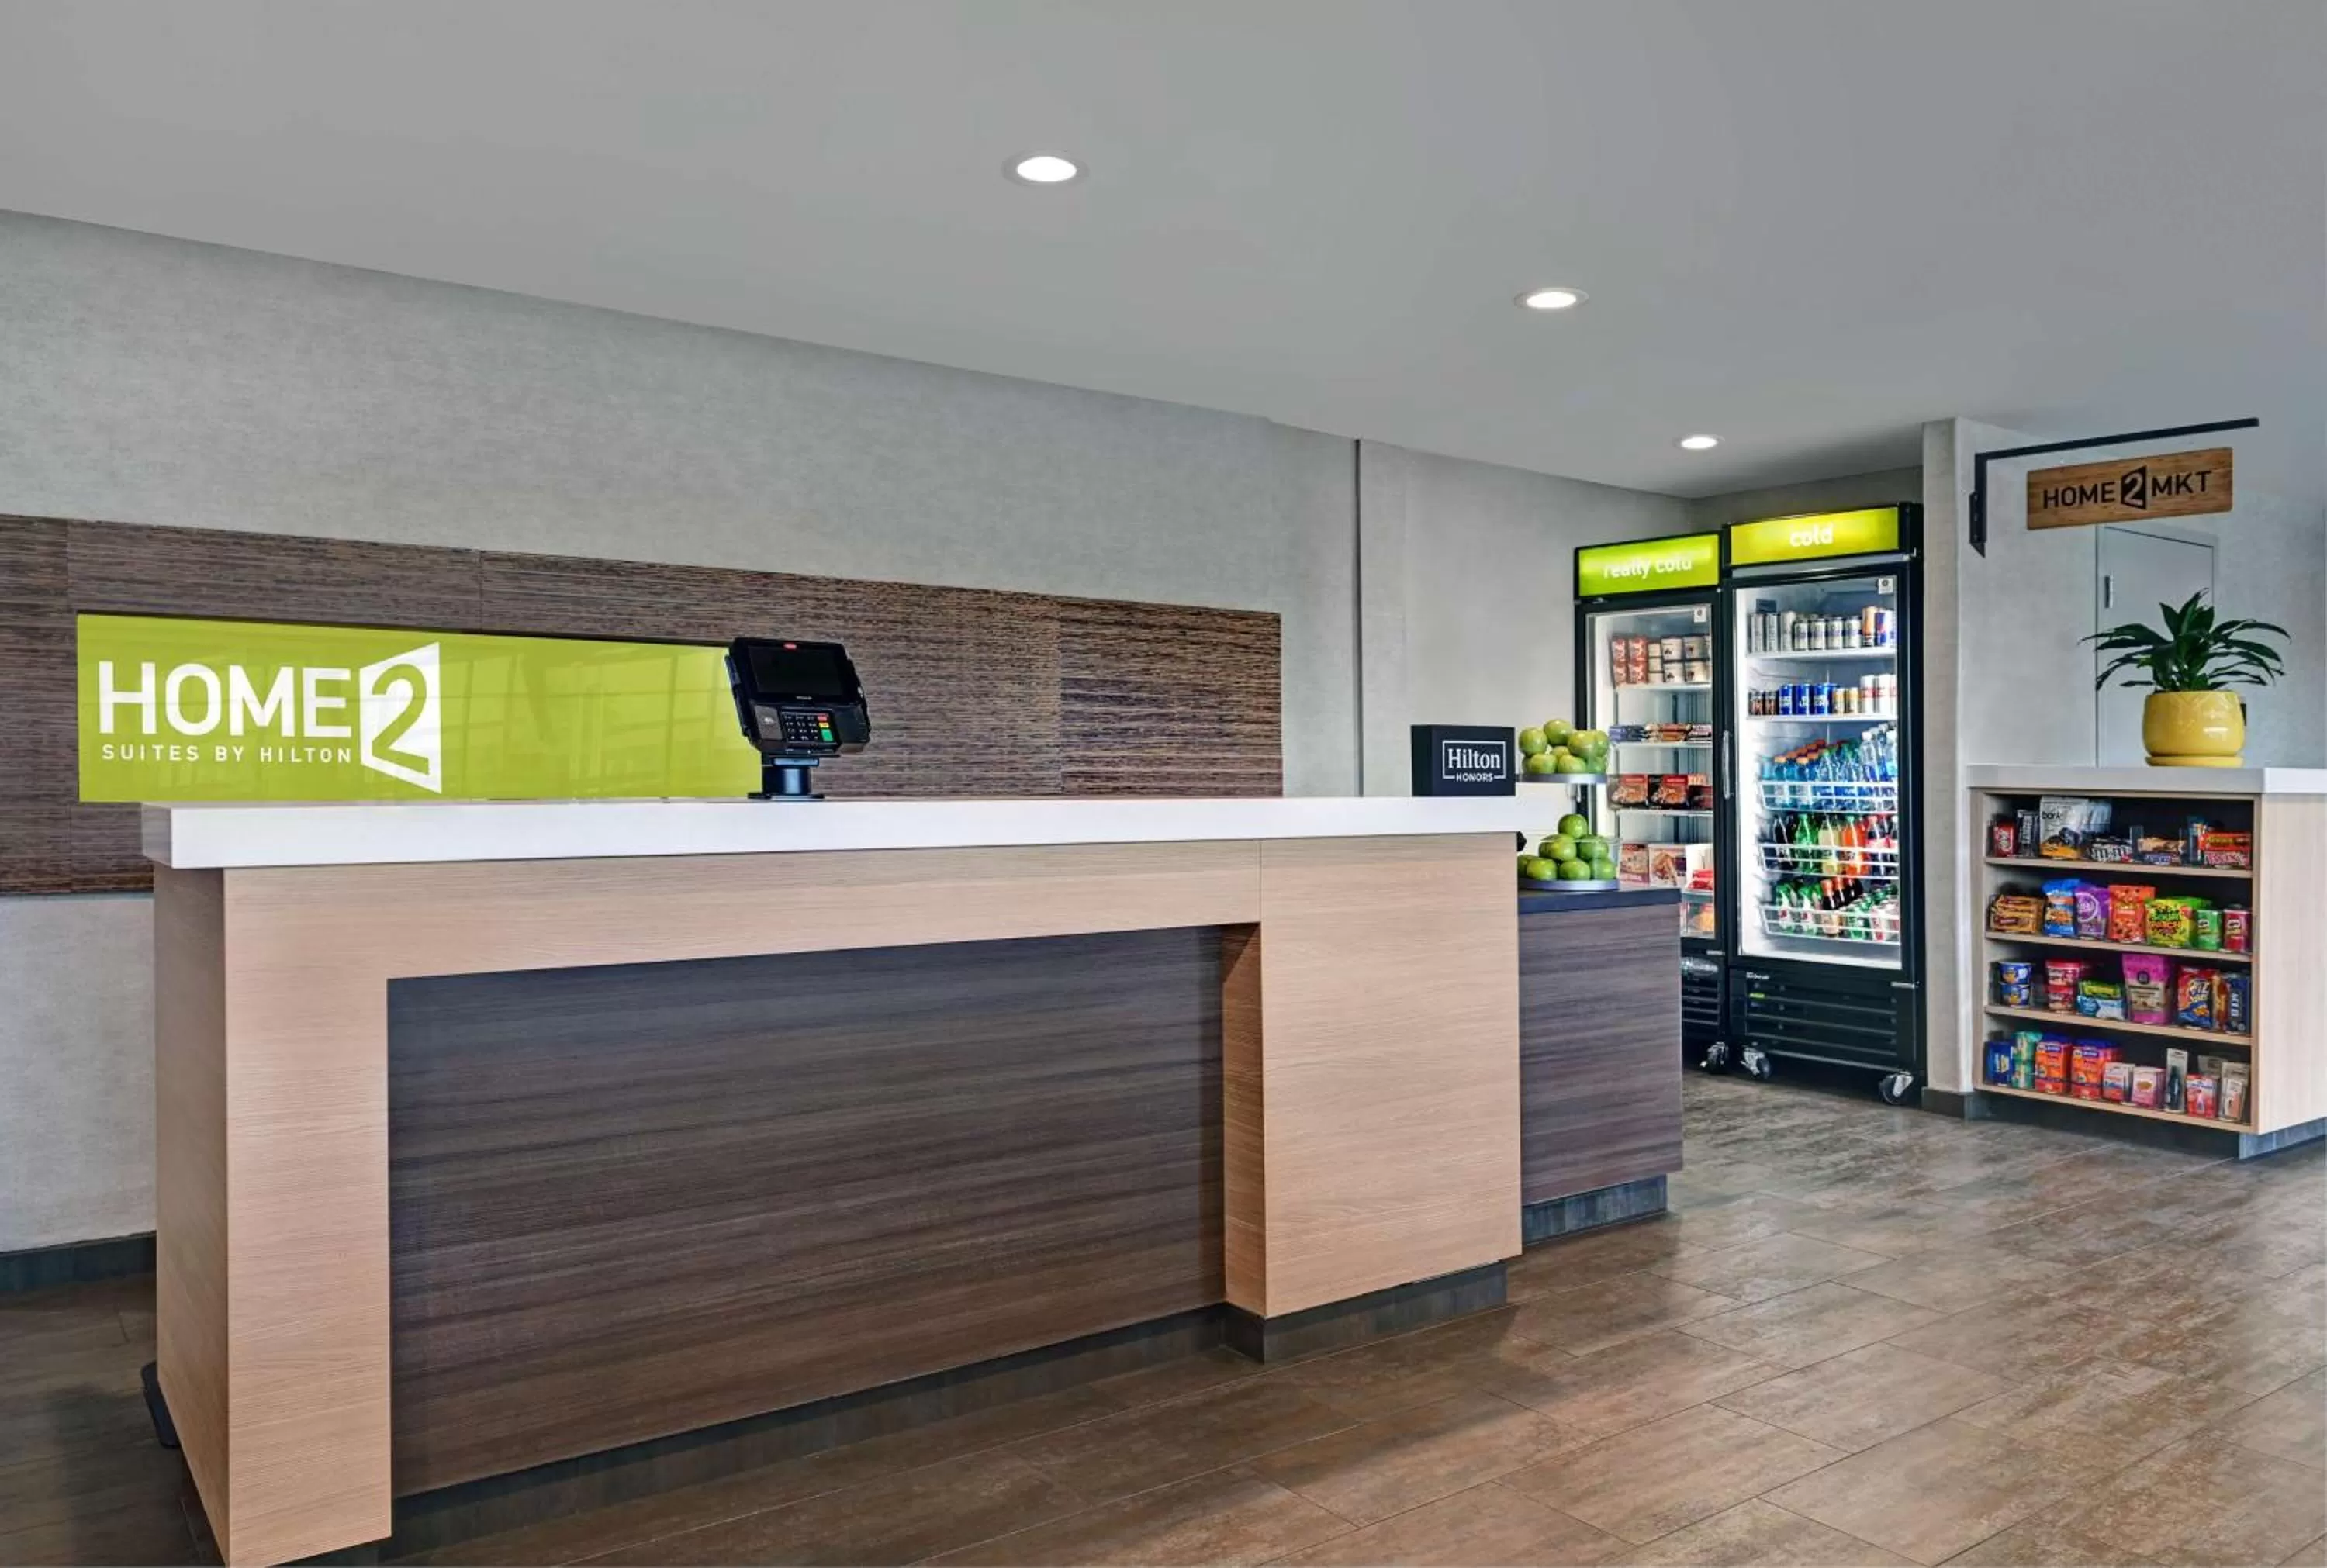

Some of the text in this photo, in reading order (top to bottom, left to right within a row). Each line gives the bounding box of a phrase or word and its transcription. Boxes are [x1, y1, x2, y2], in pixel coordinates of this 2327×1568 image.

[2152, 469, 2212, 497] MKT
[1789, 522, 1834, 547] cold
[1603, 554, 1693, 579] really cold
[102, 744, 351, 764] SUITES BY HILTON
[1447, 748, 1501, 769] Hilton
[1456, 772, 1494, 782] HONORS
